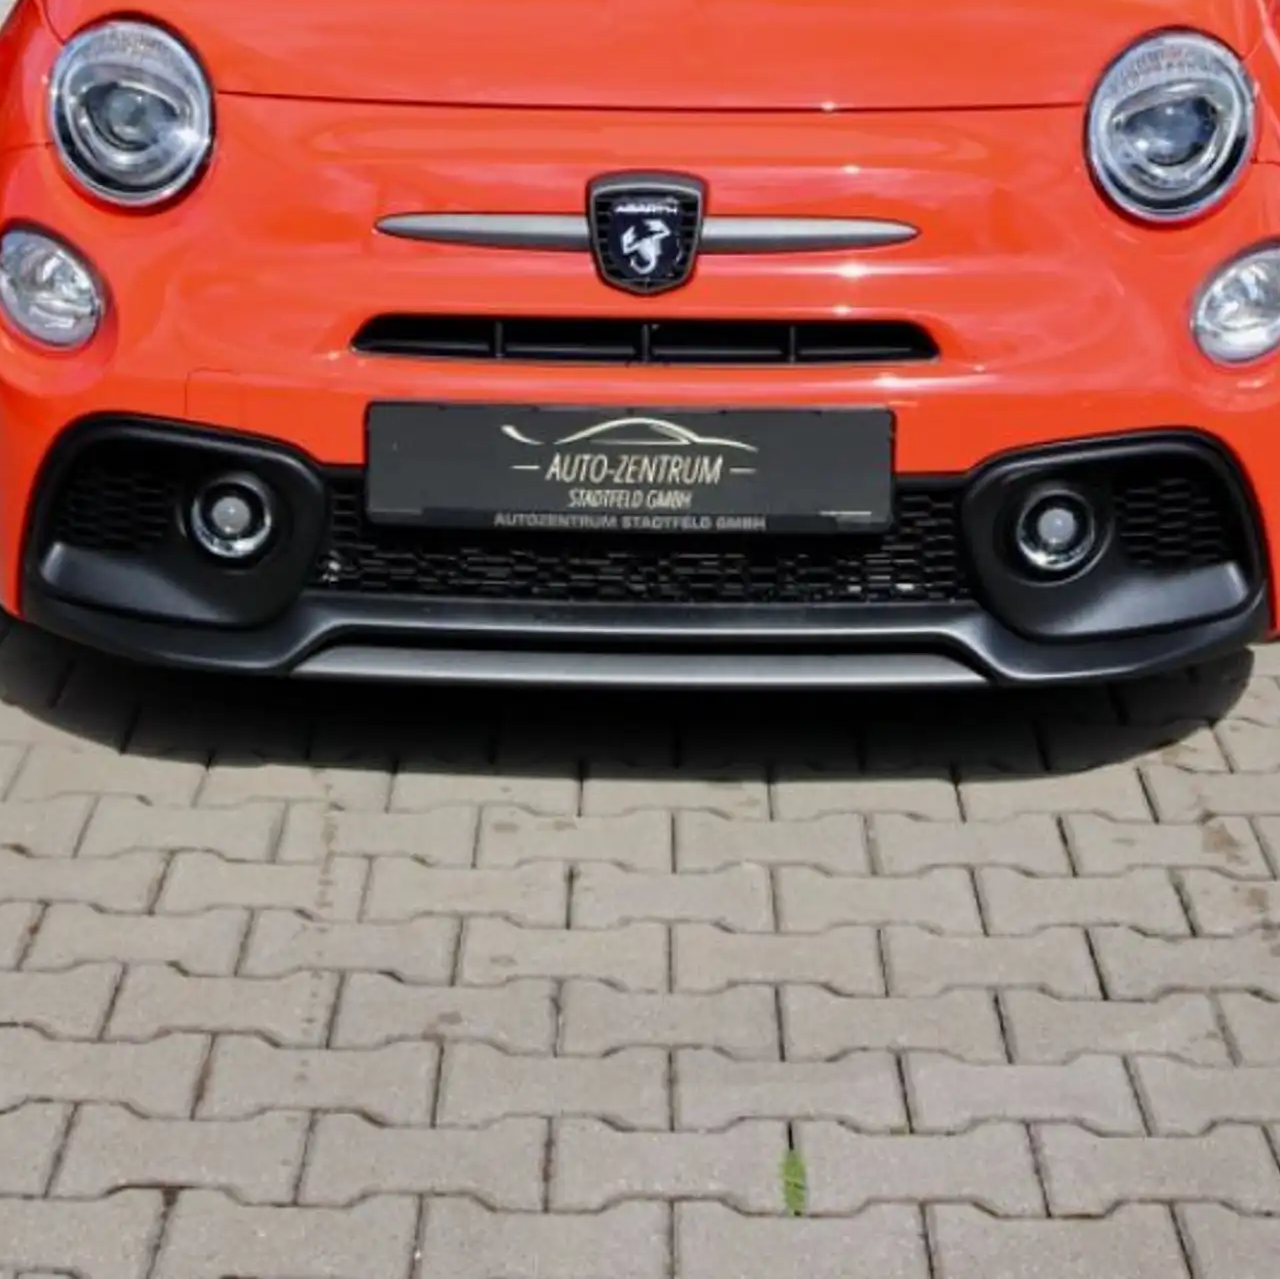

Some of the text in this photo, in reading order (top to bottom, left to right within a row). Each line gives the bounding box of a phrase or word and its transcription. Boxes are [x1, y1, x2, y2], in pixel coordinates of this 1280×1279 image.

[545, 452, 723, 485] AUTO-ZENTRUM
[568, 488, 643, 509] STADTFELD
[494, 513, 617, 529] AUTOZENTRUM
